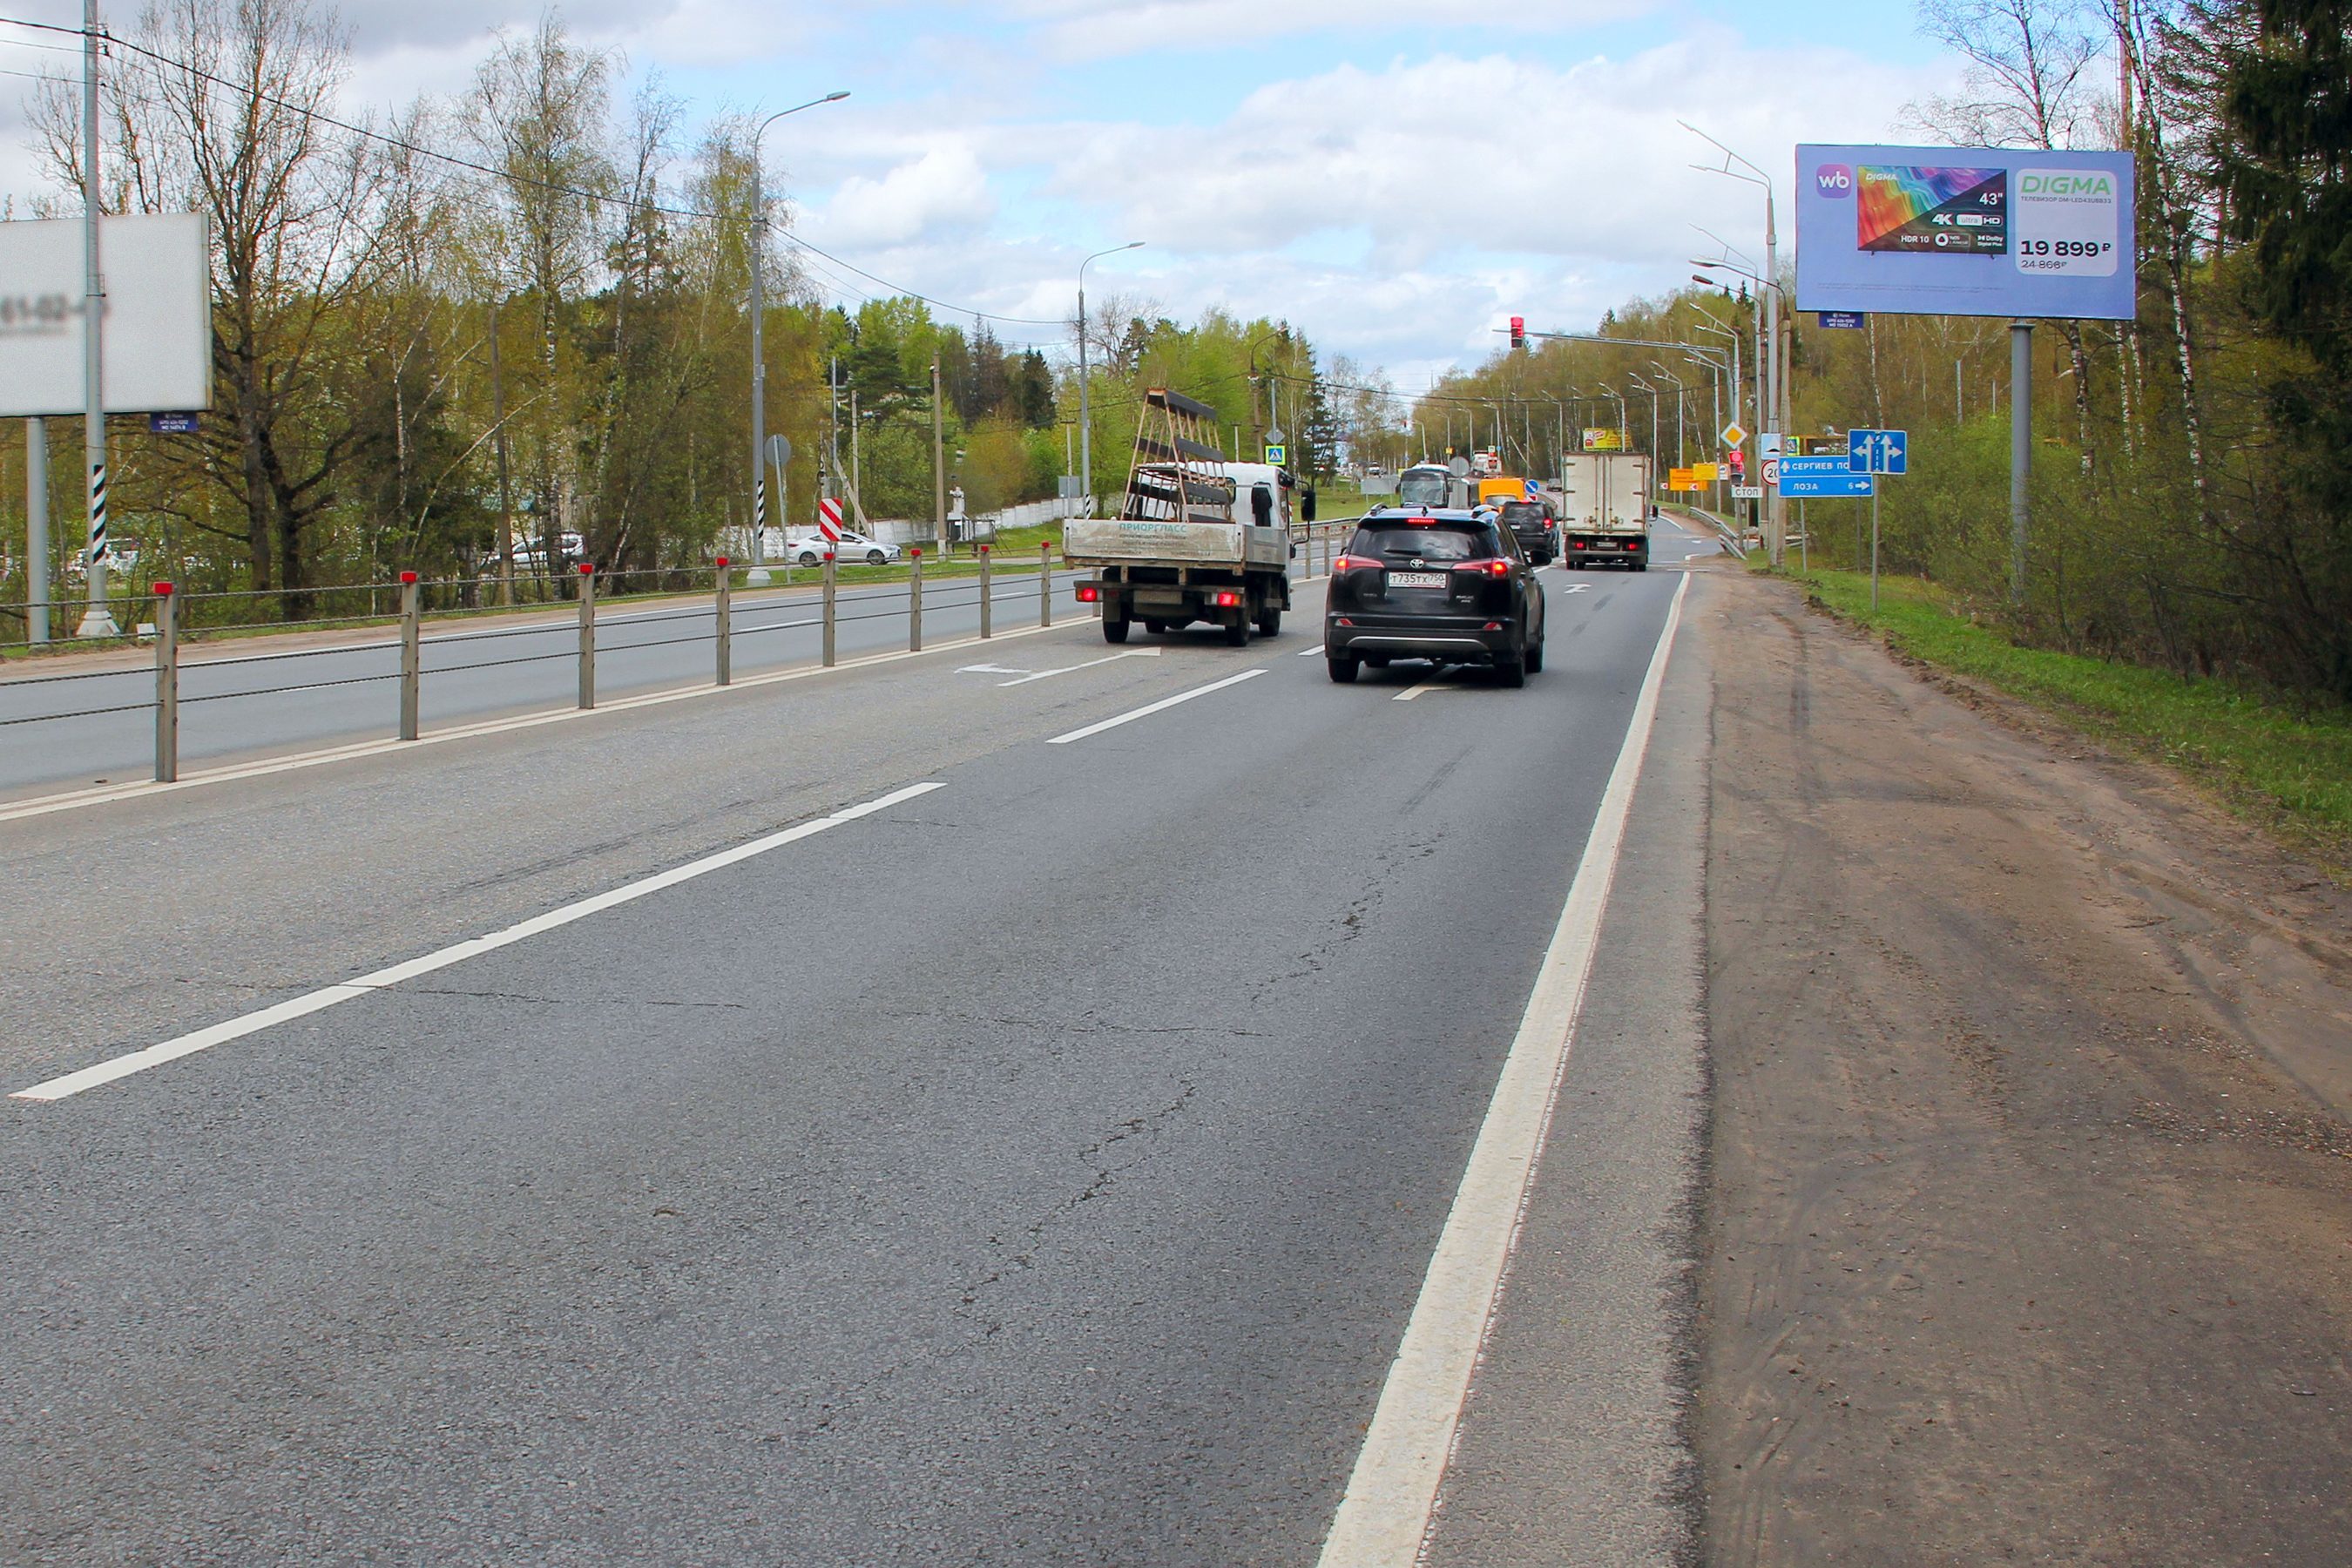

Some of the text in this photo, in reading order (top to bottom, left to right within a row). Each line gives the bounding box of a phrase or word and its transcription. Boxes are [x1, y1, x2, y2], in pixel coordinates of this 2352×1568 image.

[1818, 171, 1849, 189] wb
[2022, 176, 2111, 195] DIGMA
[1931, 213, 1952, 226] 4K
[2021, 240, 2050, 256] 19
[2055, 241, 2099, 258] 899
[1119, 523, 1186, 533] ПРИОРГЛАСС
